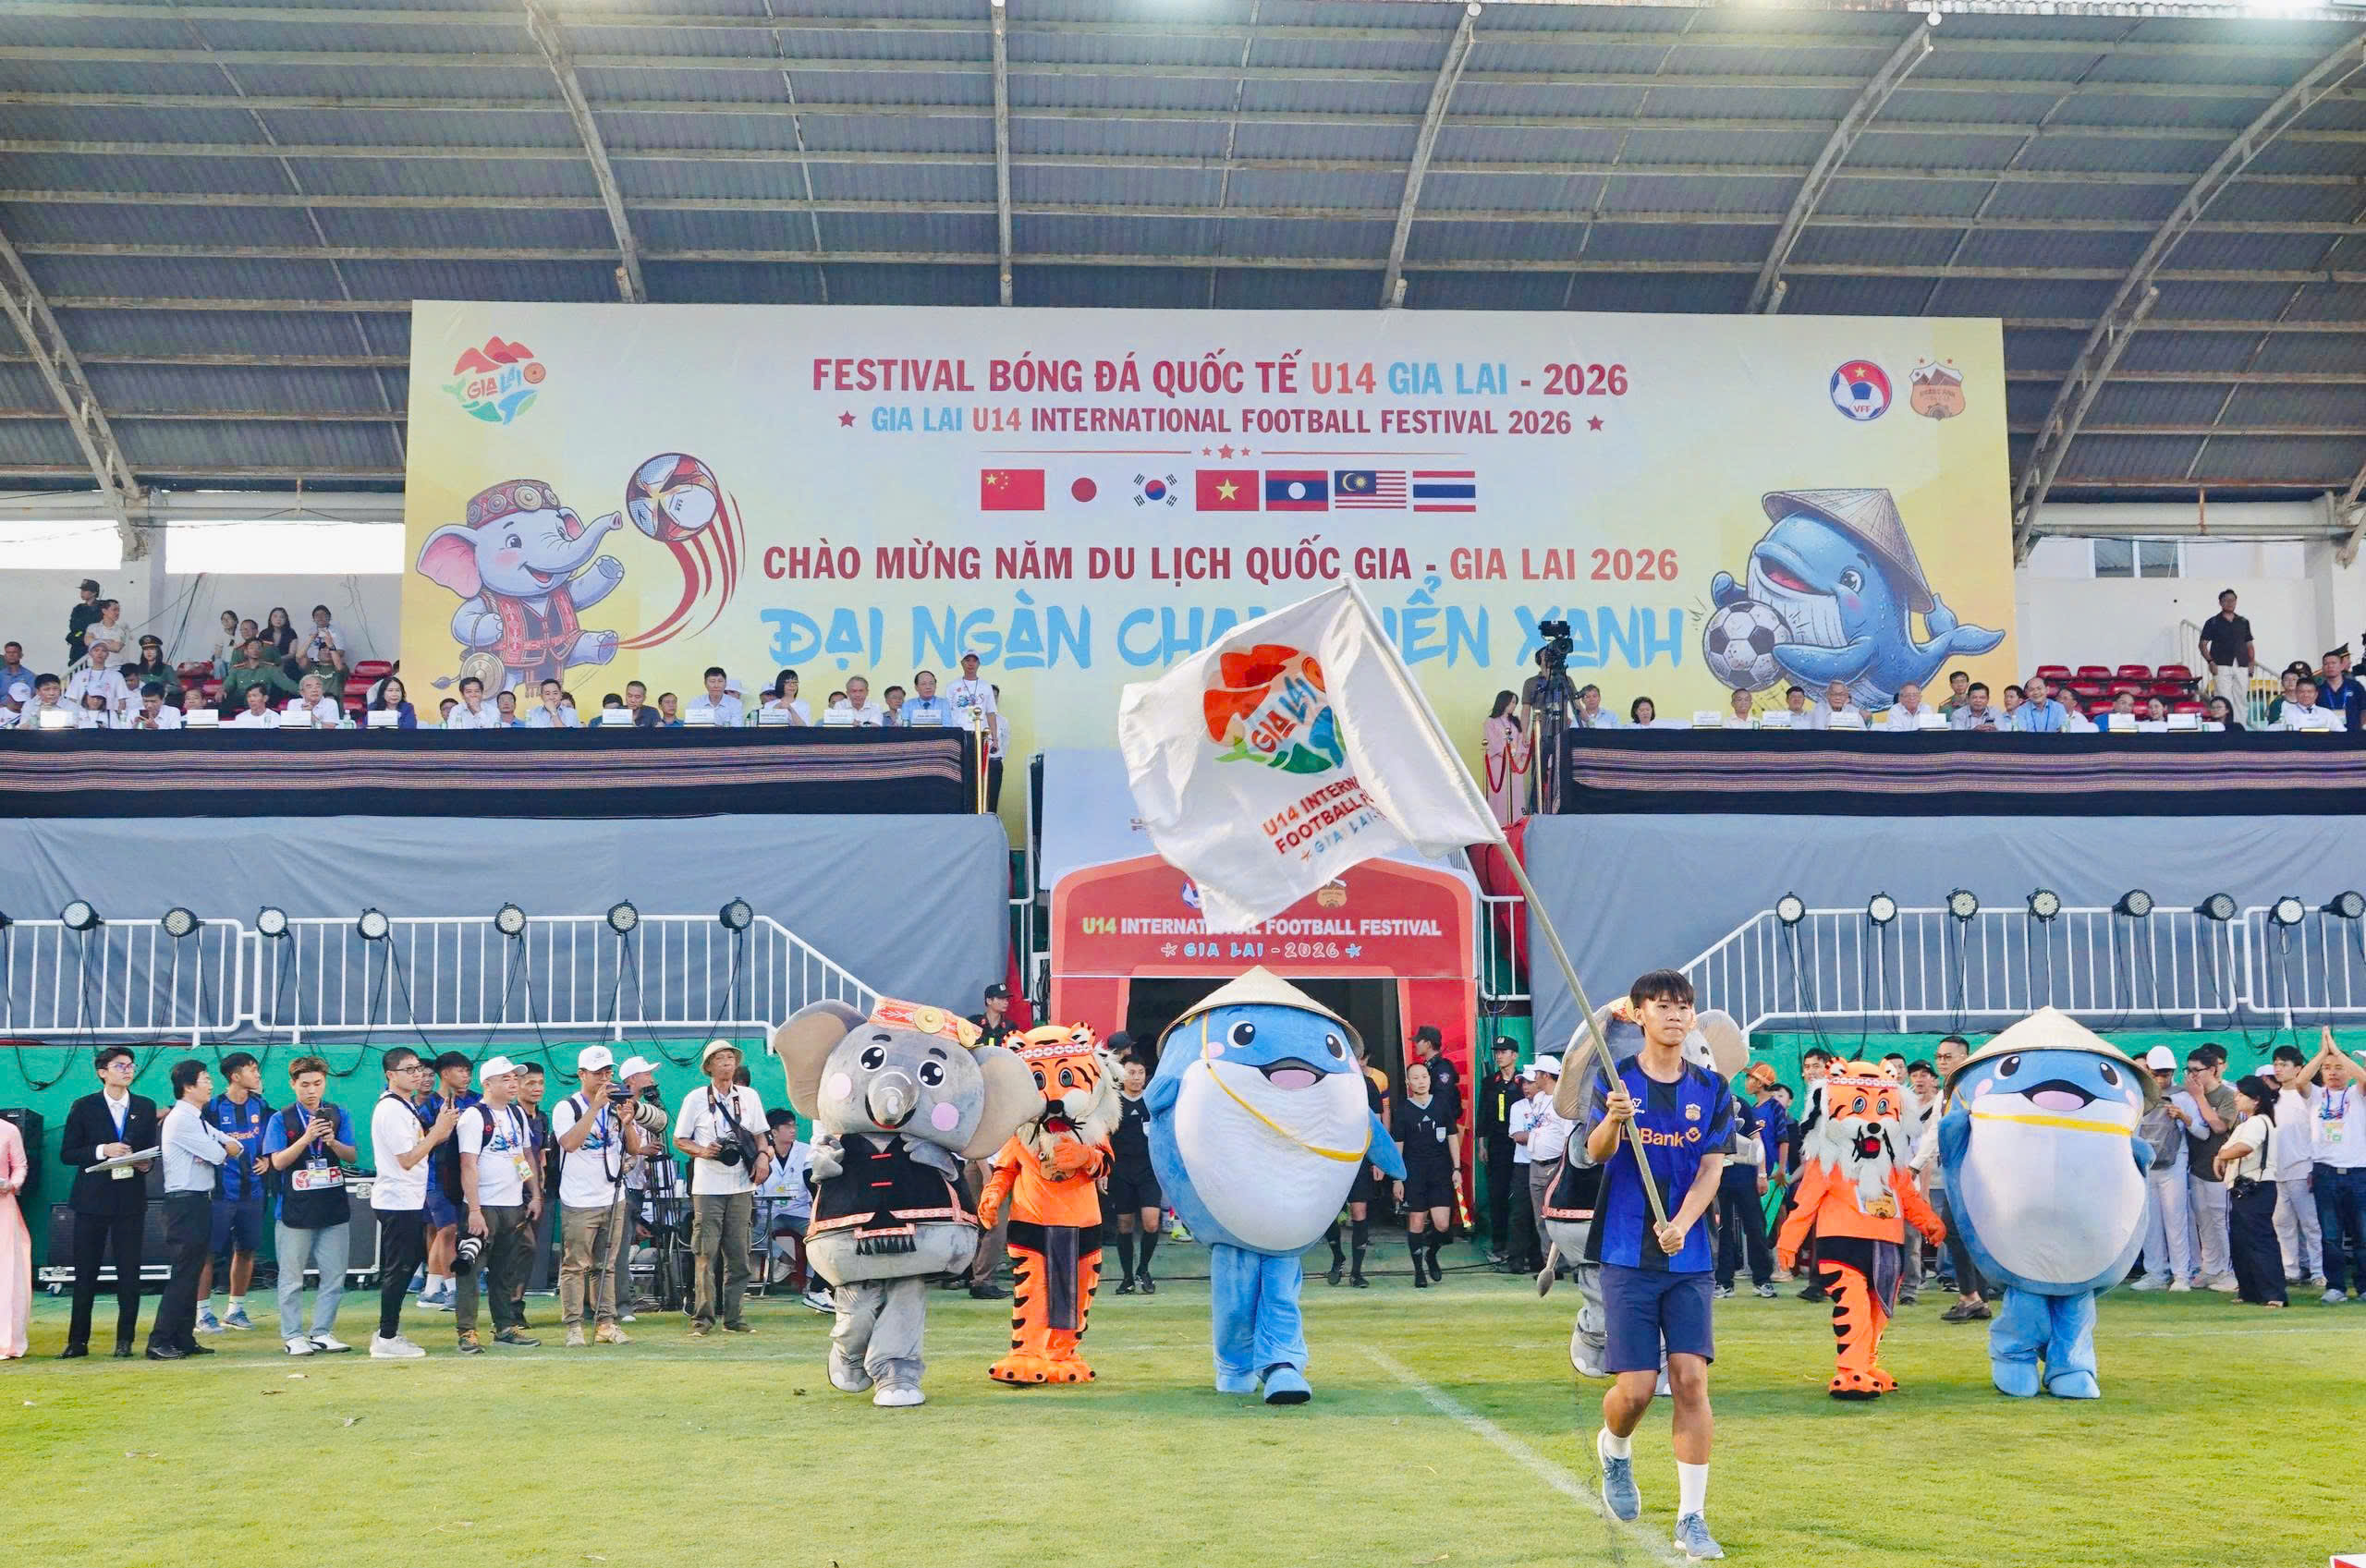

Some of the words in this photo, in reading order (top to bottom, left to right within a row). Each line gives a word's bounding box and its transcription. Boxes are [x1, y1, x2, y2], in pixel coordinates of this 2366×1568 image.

[813, 358, 975, 392] FESTIVAL
[990, 351, 1082, 393] BÓNG
[1094, 352, 1140, 393] ĐÁ
[1153, 348, 1244, 398] QUỐC
[1255, 348, 1302, 394] TẾ
[1311, 361, 1376, 395] U14
[1387, 361, 1443, 395] GIA
[1457, 362, 1508, 395] LAI
[1543, 363, 1628, 396] 2026
[872, 406, 914, 432] GIA
[923, 407, 963, 432] LAI
[973, 407, 1022, 432] U14
[1031, 407, 1231, 433] INTERNATIONAL
[1242, 408, 1371, 434] FOOTBALL
[1382, 409, 1498, 434] FESTIVAL
[1508, 409, 1572, 434] 2026
[763, 538, 861, 580] CHÀO
[876, 538, 981, 580] MỪNG
[995, 540, 1073, 580] NĂM
[1089, 546, 1136, 580] DU
[1152, 546, 1231, 587] LỊCH
[1246, 533, 1341, 586] QUỐC
[1354, 547, 1412, 580] GIA
[1450, 547, 1508, 581] GIA
[1522, 548, 1577, 581] LAI
[1591, 548, 1678, 581] 2026
[760, 605, 884, 671] ĐẠI
[911, 588, 1092, 671] NGÀN
[1382, 575, 1491, 668] IỂN
[1513, 605, 1684, 669] XANH
[1251, 710, 1297, 753] GIA
[1279, 675, 1317, 724] LAI
[1262, 805, 1299, 836] U14
[1274, 796, 1362, 855] FOOTBALL
[1082, 918, 1116, 934] U14
[1266, 918, 1356, 935] FOOTBALL
[1360, 919, 1442, 936] FESTIVAL
[1184, 942, 1220, 958] GIA
[1230, 942, 1264, 958] LAI
[1285, 942, 1340, 958] 2026
[1621, 1124, 1686, 1148] LBank
